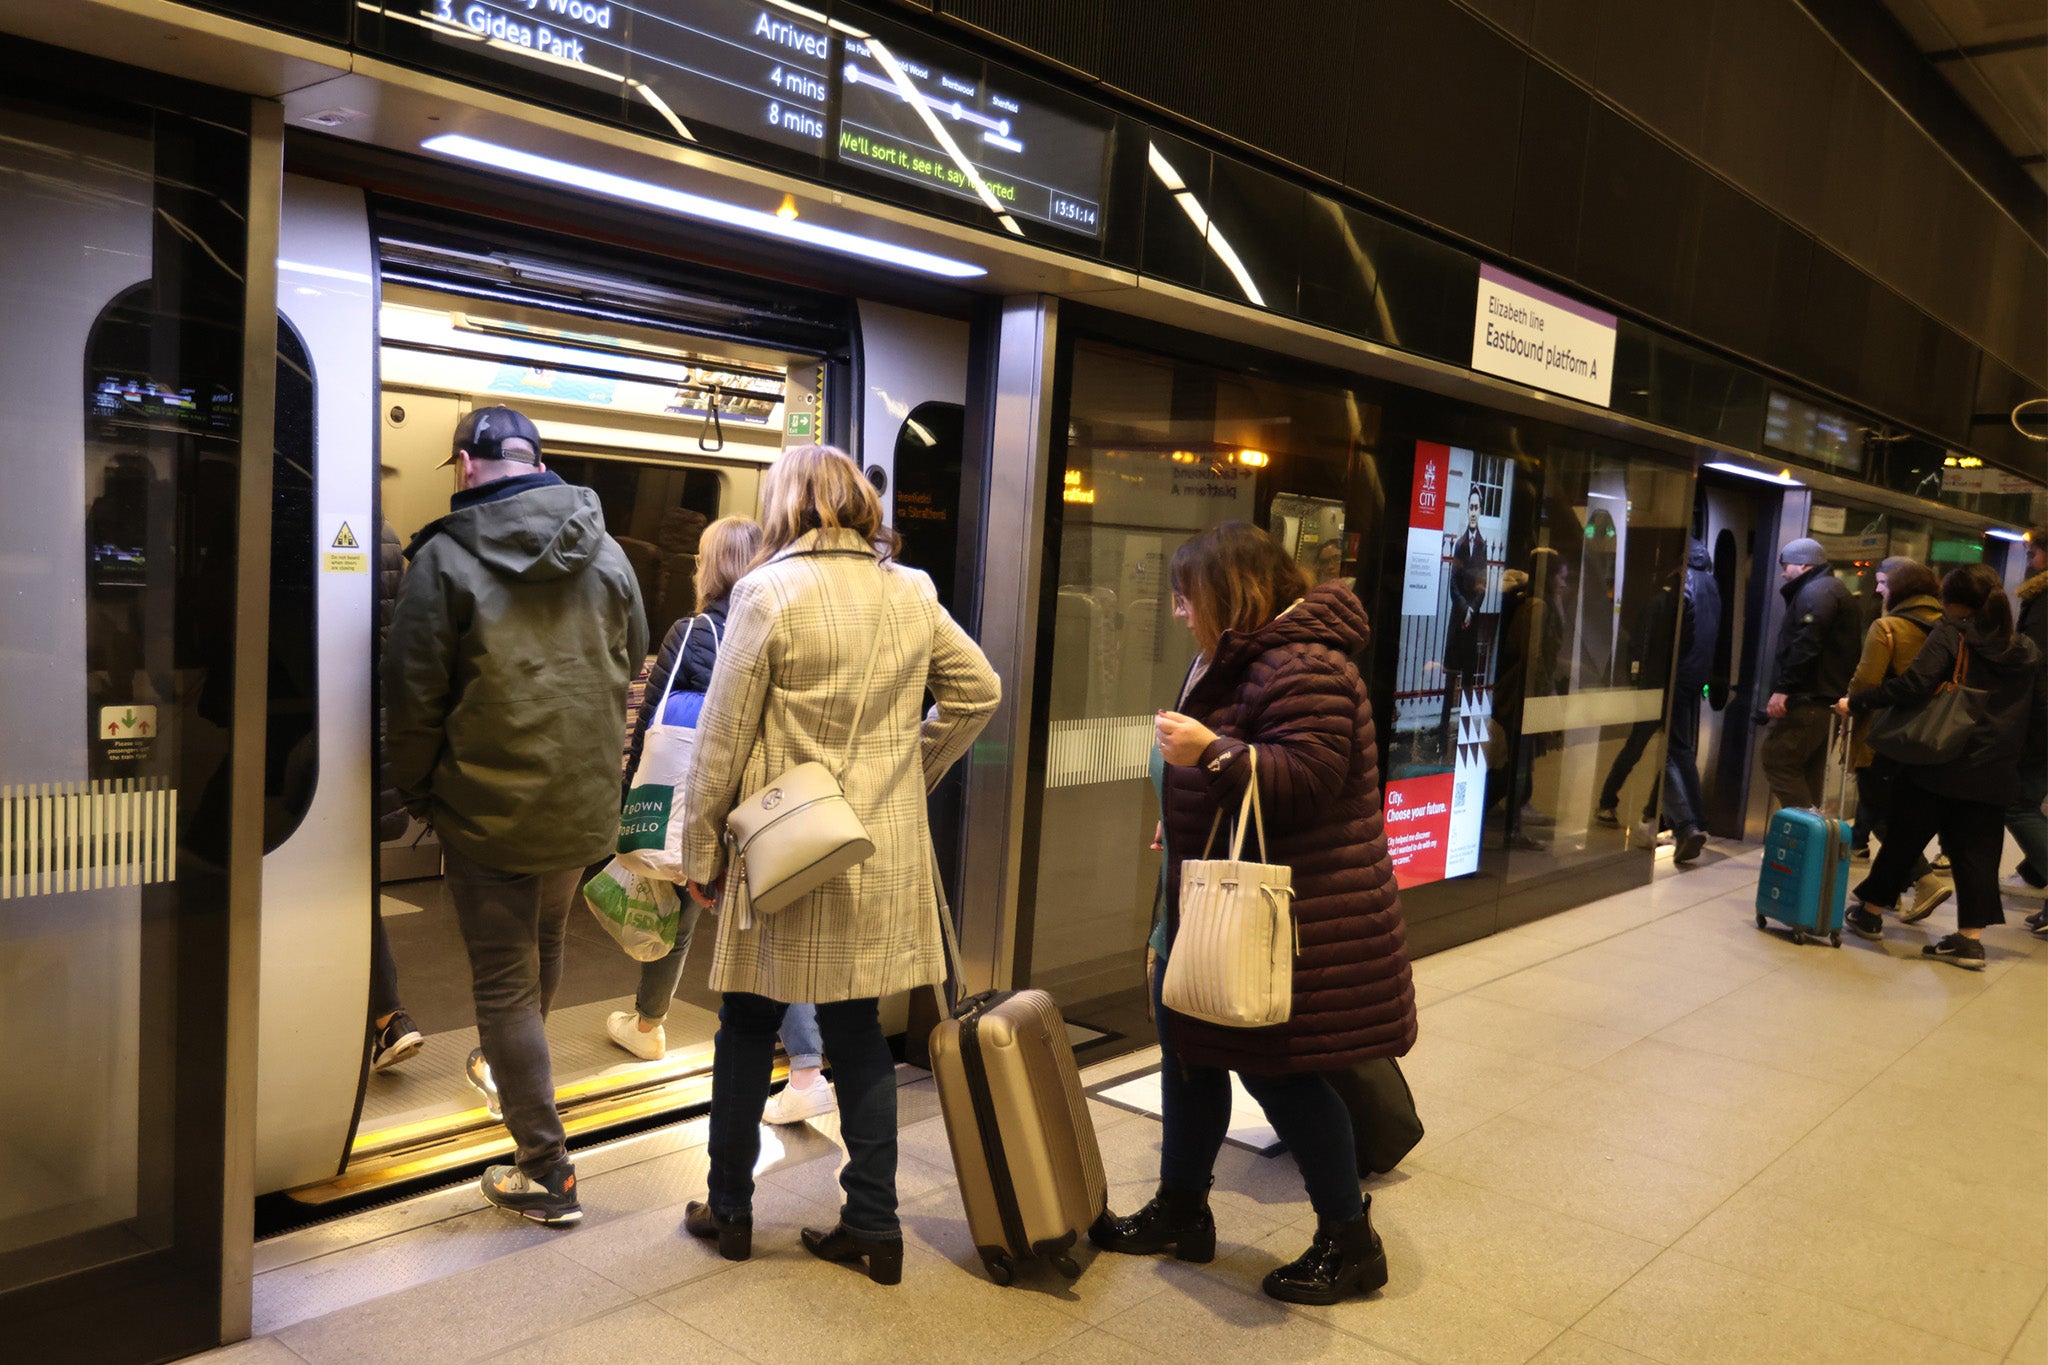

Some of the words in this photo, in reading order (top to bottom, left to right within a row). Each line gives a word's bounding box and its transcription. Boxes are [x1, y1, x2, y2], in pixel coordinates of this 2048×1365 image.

[467, 5, 531, 48] Gidea
[538, 27, 584, 63] Park
[755, 12, 828, 60] Arrived
[771, 66, 782, 87] 4
[786, 75, 826, 101] mins
[909, 64, 928, 80] Wood
[941, 77, 974, 97] Brentwood
[992, 96, 1018, 113] Shenfield
[769, 102, 779, 125] 8
[783, 112, 823, 139] mins
[840, 131, 869, 156] We'll
[871, 146, 896, 164] sort
[899, 151, 910, 169] it,
[912, 158, 931, 174] see
[934, 163, 945, 181] it,
[947, 169, 966, 187] say
[984, 178, 1017, 202] orted.
[1055, 200, 1095, 225] 13:51:14
[1488, 295, 1528, 326] Elizabeth
[1529, 312, 1545, 332] line
[1486, 322, 1545, 362] Eastbound
[1545, 345, 1588, 377] platform
[1590, 359, 1598, 380] A
[1419, 492, 1437, 507] CITY
[1386, 808, 1411, 823] Choose
[1410, 806, 1426, 822] your
[1426, 802, 1447, 816] future.
[1388, 791, 1403, 807] City.
